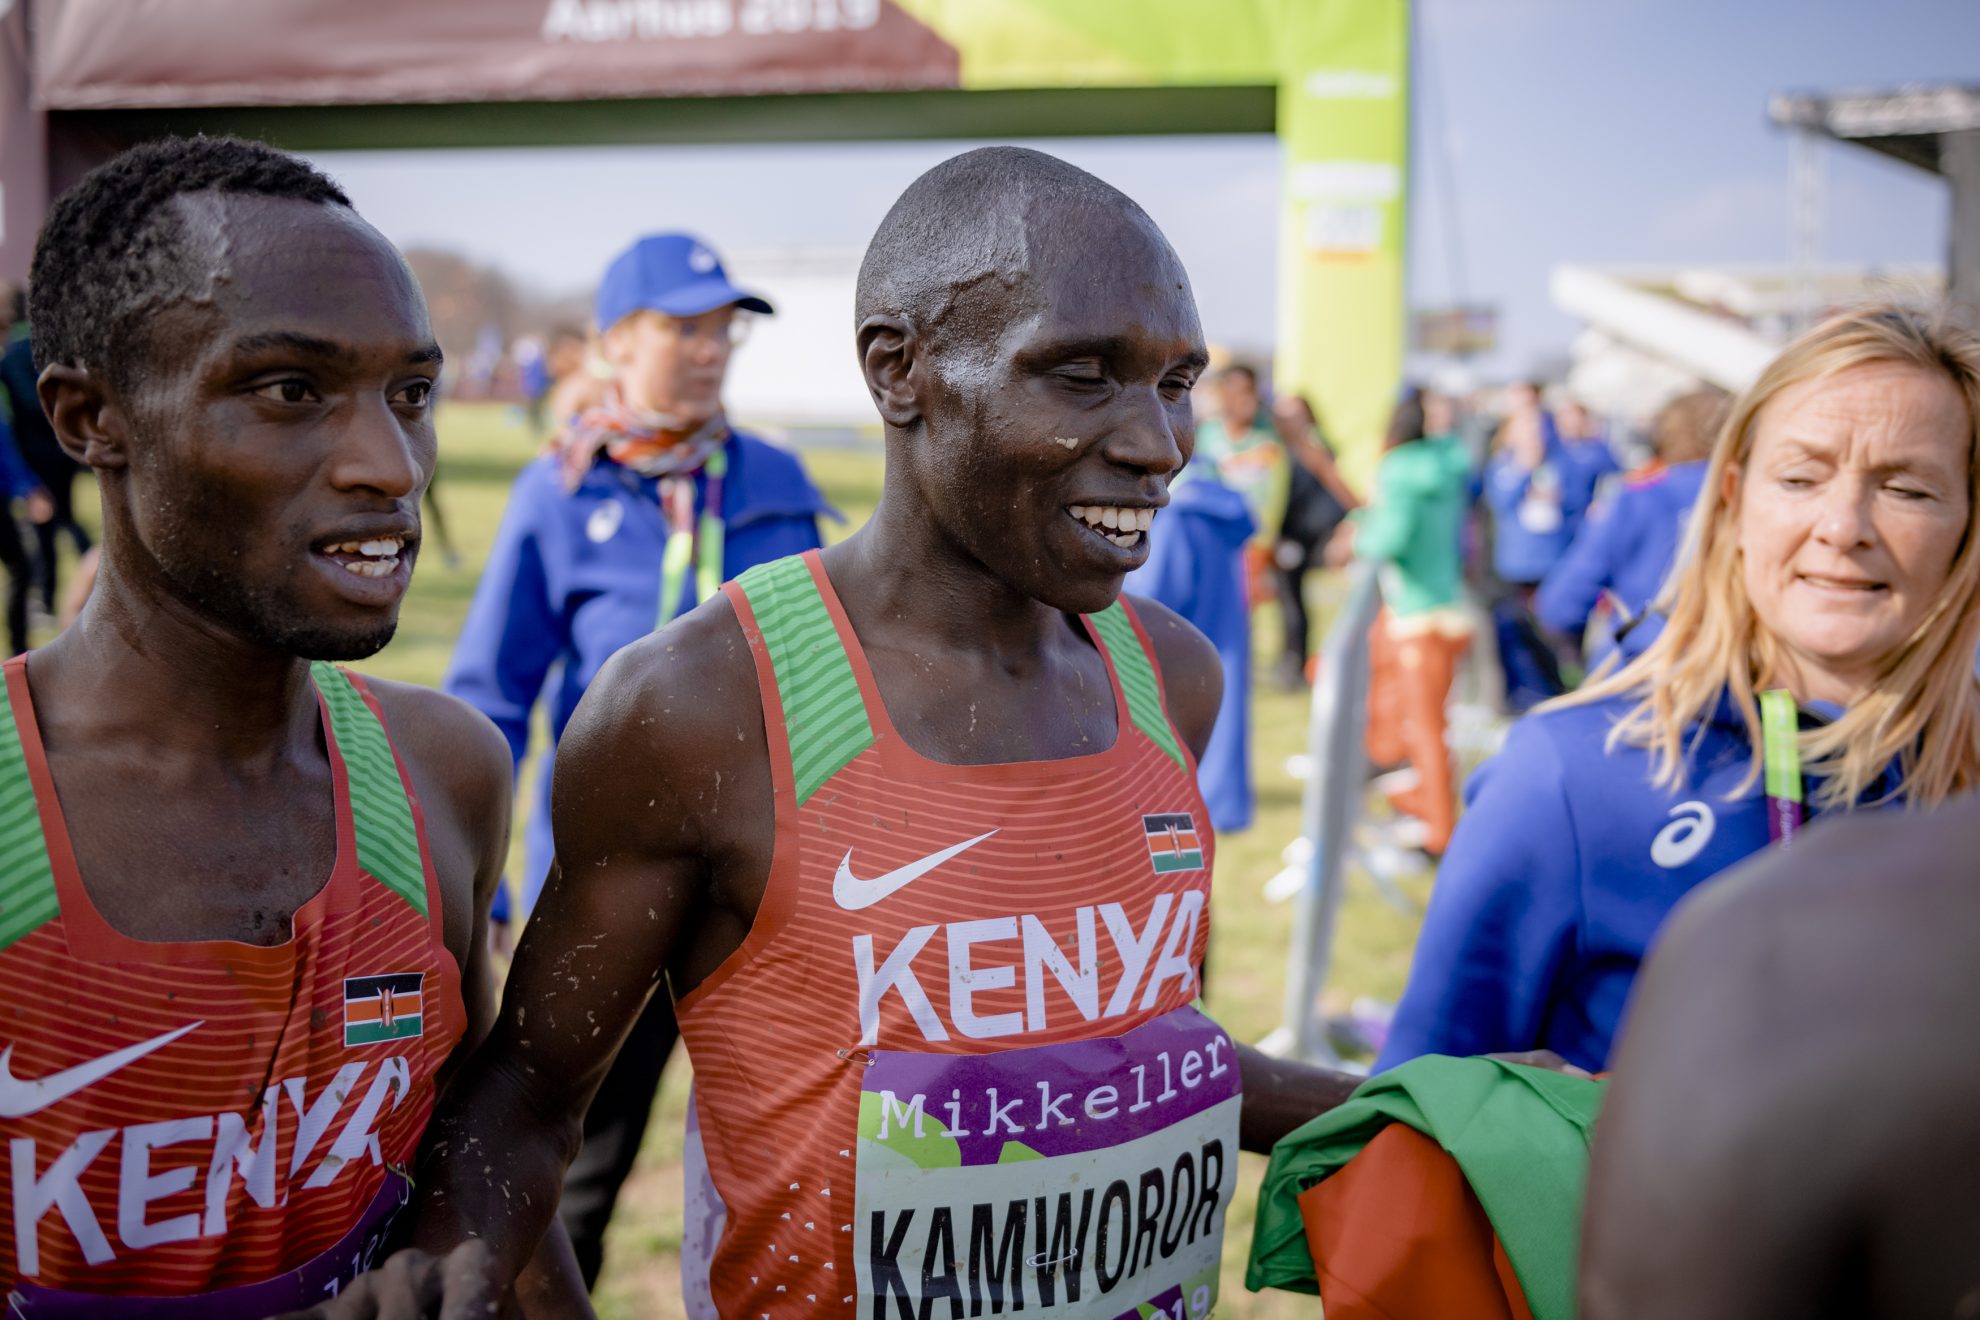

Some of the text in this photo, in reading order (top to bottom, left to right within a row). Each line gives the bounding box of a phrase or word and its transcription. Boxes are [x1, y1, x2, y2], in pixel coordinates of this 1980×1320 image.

[853, 889, 1205, 1046] KENYA
[10, 1056, 411, 1277] KENYA
[877, 1033, 1228, 1139] Mikkeller
[869, 1138, 1224, 1320] KAMWOROR
